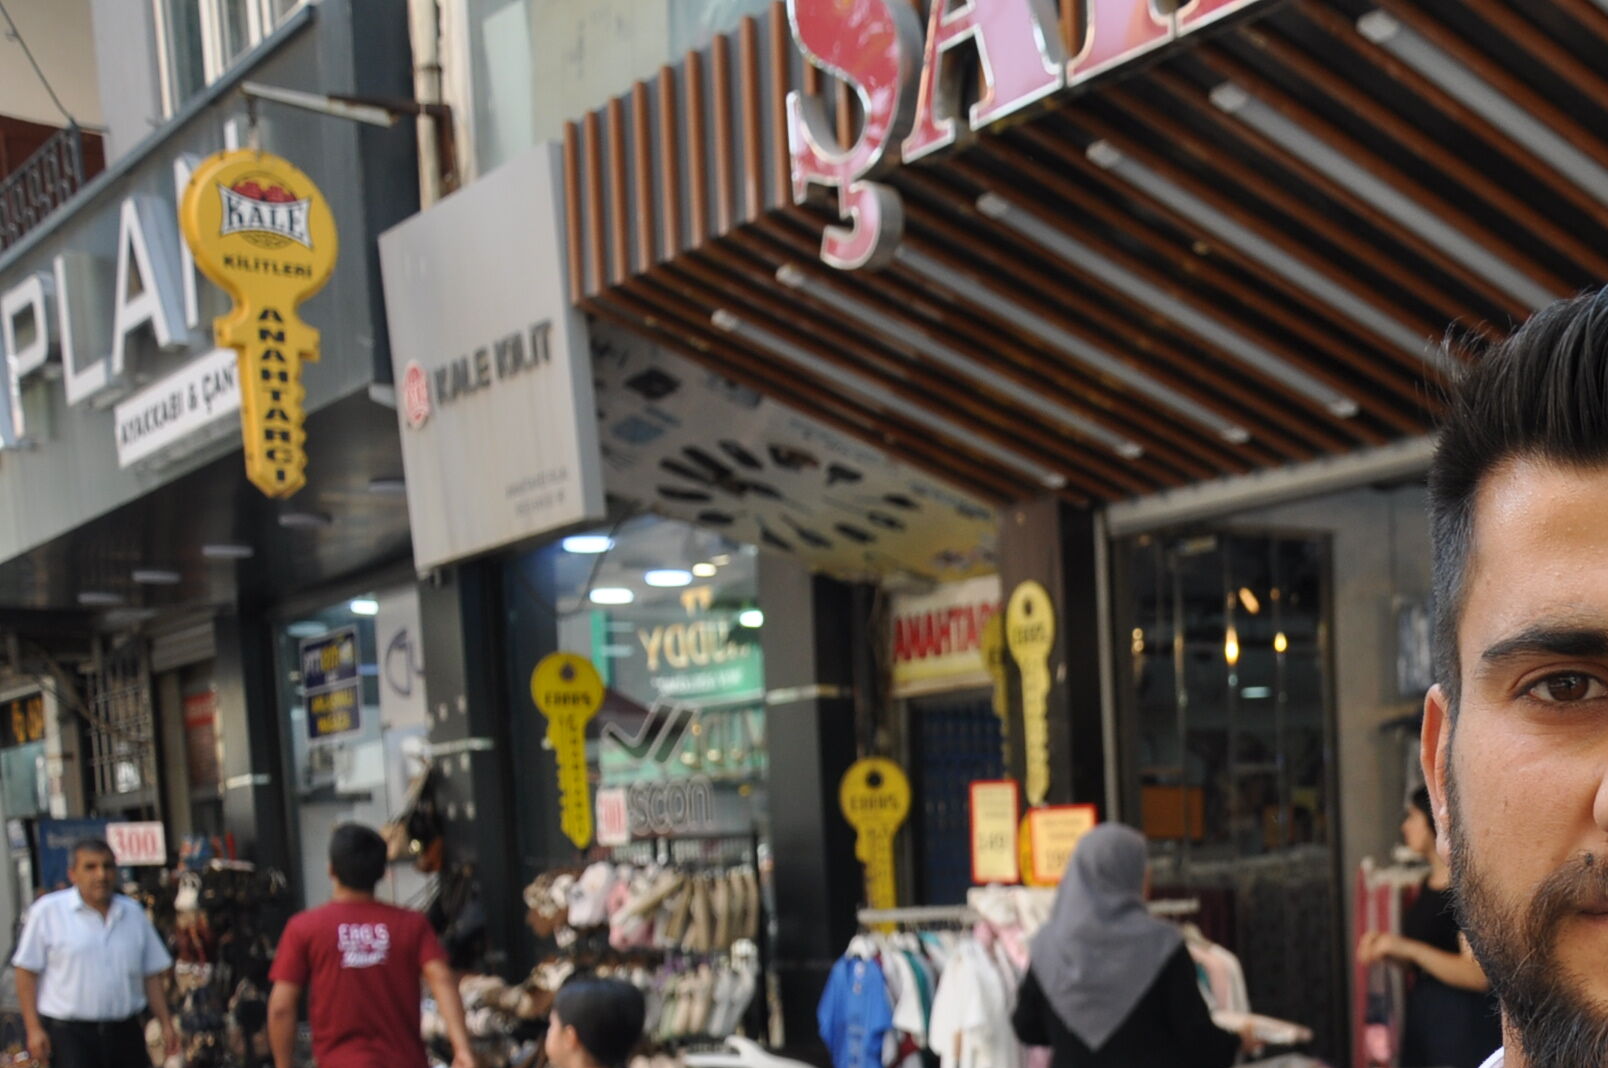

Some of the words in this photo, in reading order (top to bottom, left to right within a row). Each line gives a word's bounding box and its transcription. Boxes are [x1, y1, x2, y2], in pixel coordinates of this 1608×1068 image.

[226, 196, 307, 237] KALE
[257, 307, 293, 482] ANAHTARCI
[434, 346, 492, 406] KALE
